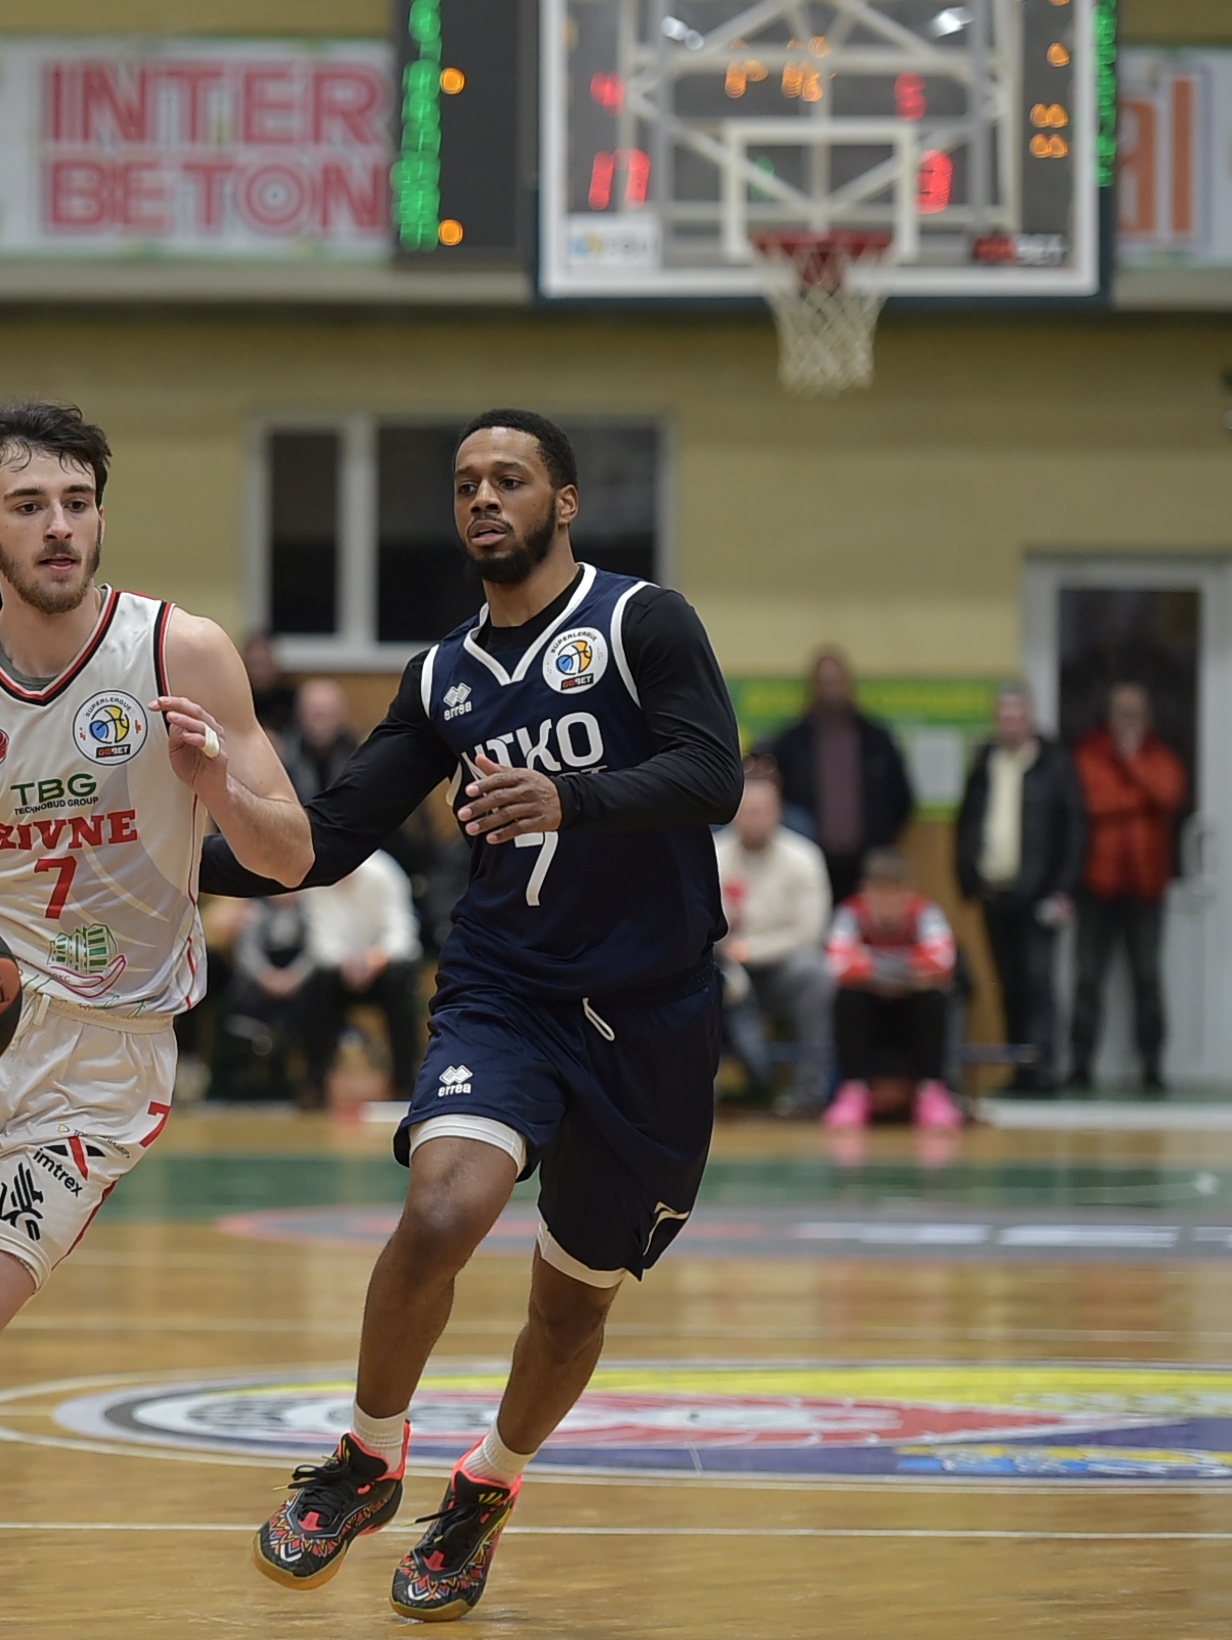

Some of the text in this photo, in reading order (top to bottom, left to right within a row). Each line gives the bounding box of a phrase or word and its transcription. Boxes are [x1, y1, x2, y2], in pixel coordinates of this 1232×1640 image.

[44, 62, 386, 146] INTER
[46, 156, 388, 235] BETON
[551, 631, 597, 654] SUPERLEAGUE
[85, 697, 132, 717] SUPERLEAGUE
[443, 700, 472, 721] errea
[10, 773, 97, 806] TBG
[67, 796, 99, 807] GROUP
[34, 855, 78, 920] 7
[514, 831, 559, 907] 7
[437, 1083, 472, 1097] errea
[147, 1101, 171, 1149] 7
[33, 1147, 83, 1198] imtrex
